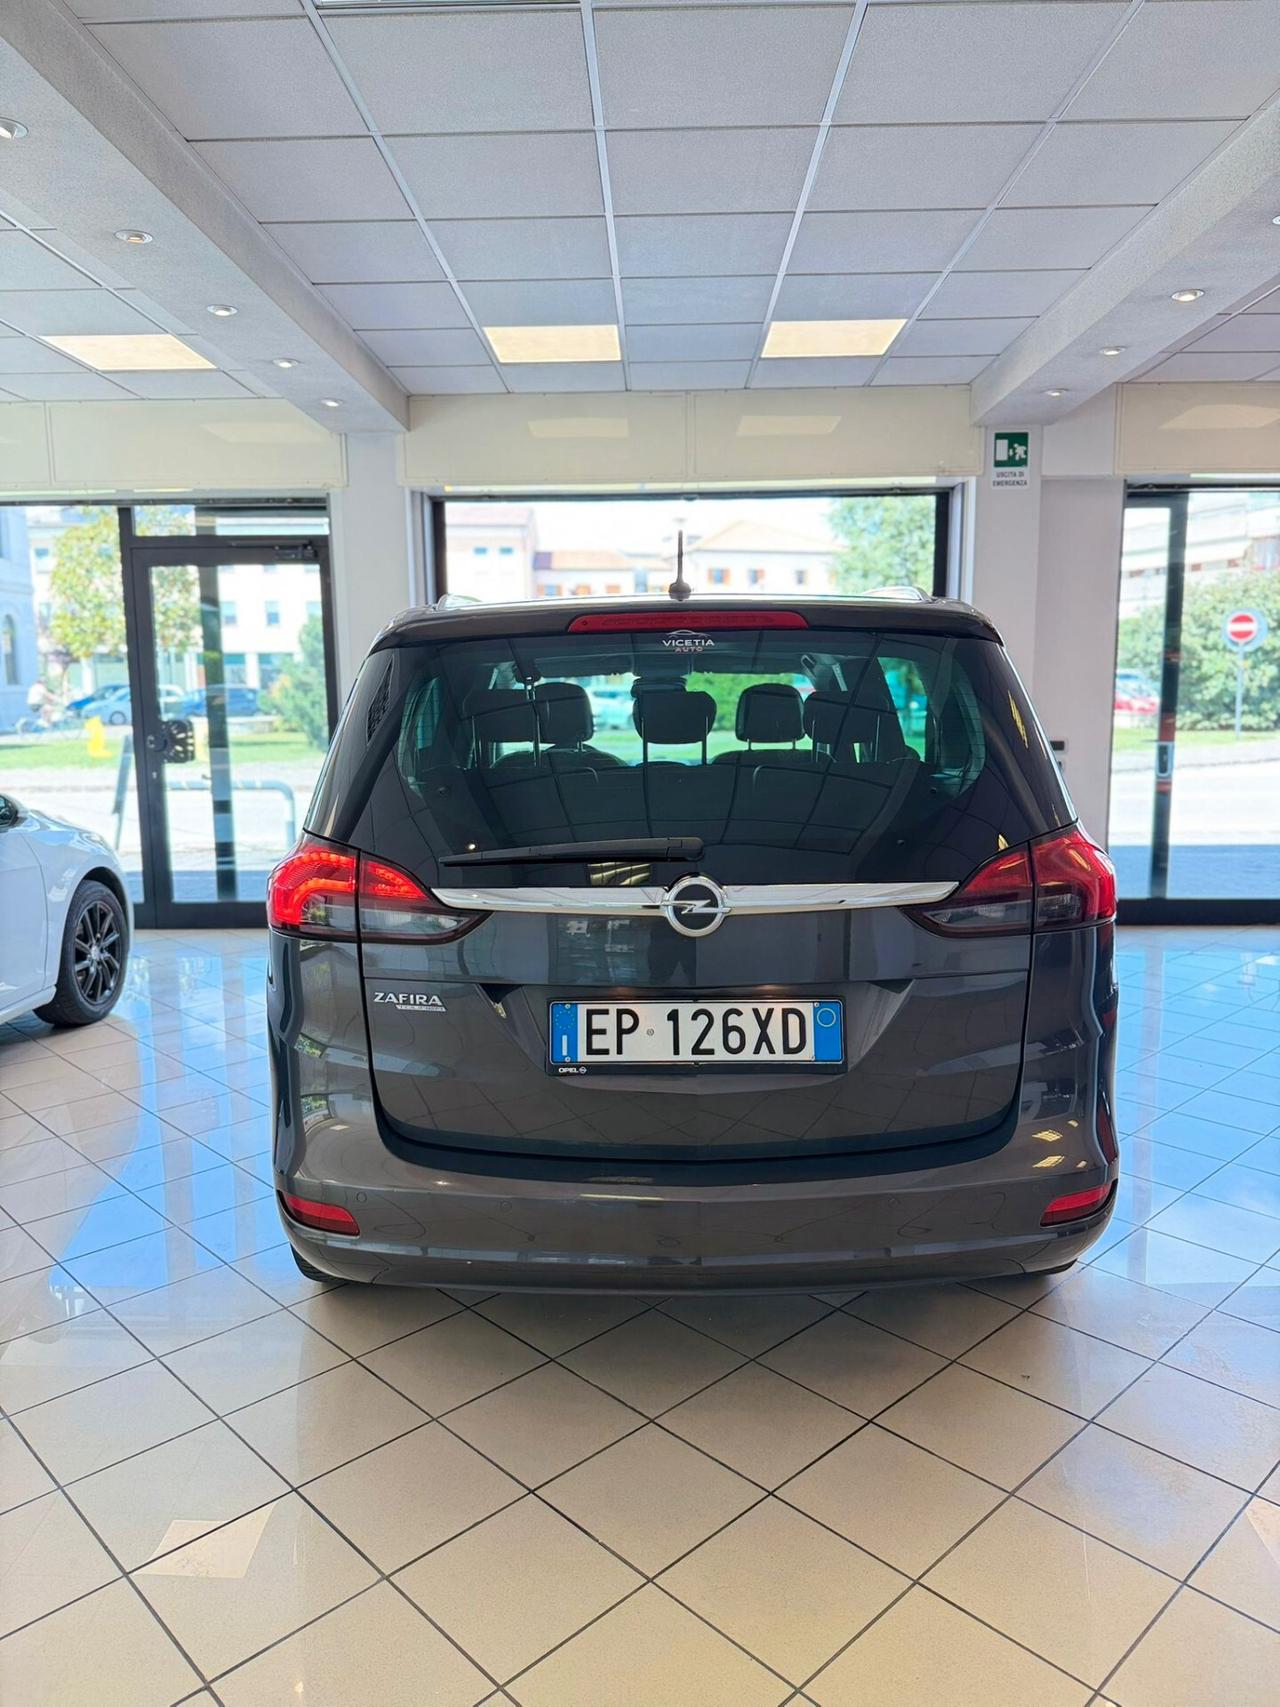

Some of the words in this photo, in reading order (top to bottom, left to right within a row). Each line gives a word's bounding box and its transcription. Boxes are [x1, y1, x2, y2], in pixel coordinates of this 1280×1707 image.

[374, 992, 442, 1005] ZAFIRA
[586, 1008, 640, 1056] EP
[666, 1007, 806, 1056] 126XD
